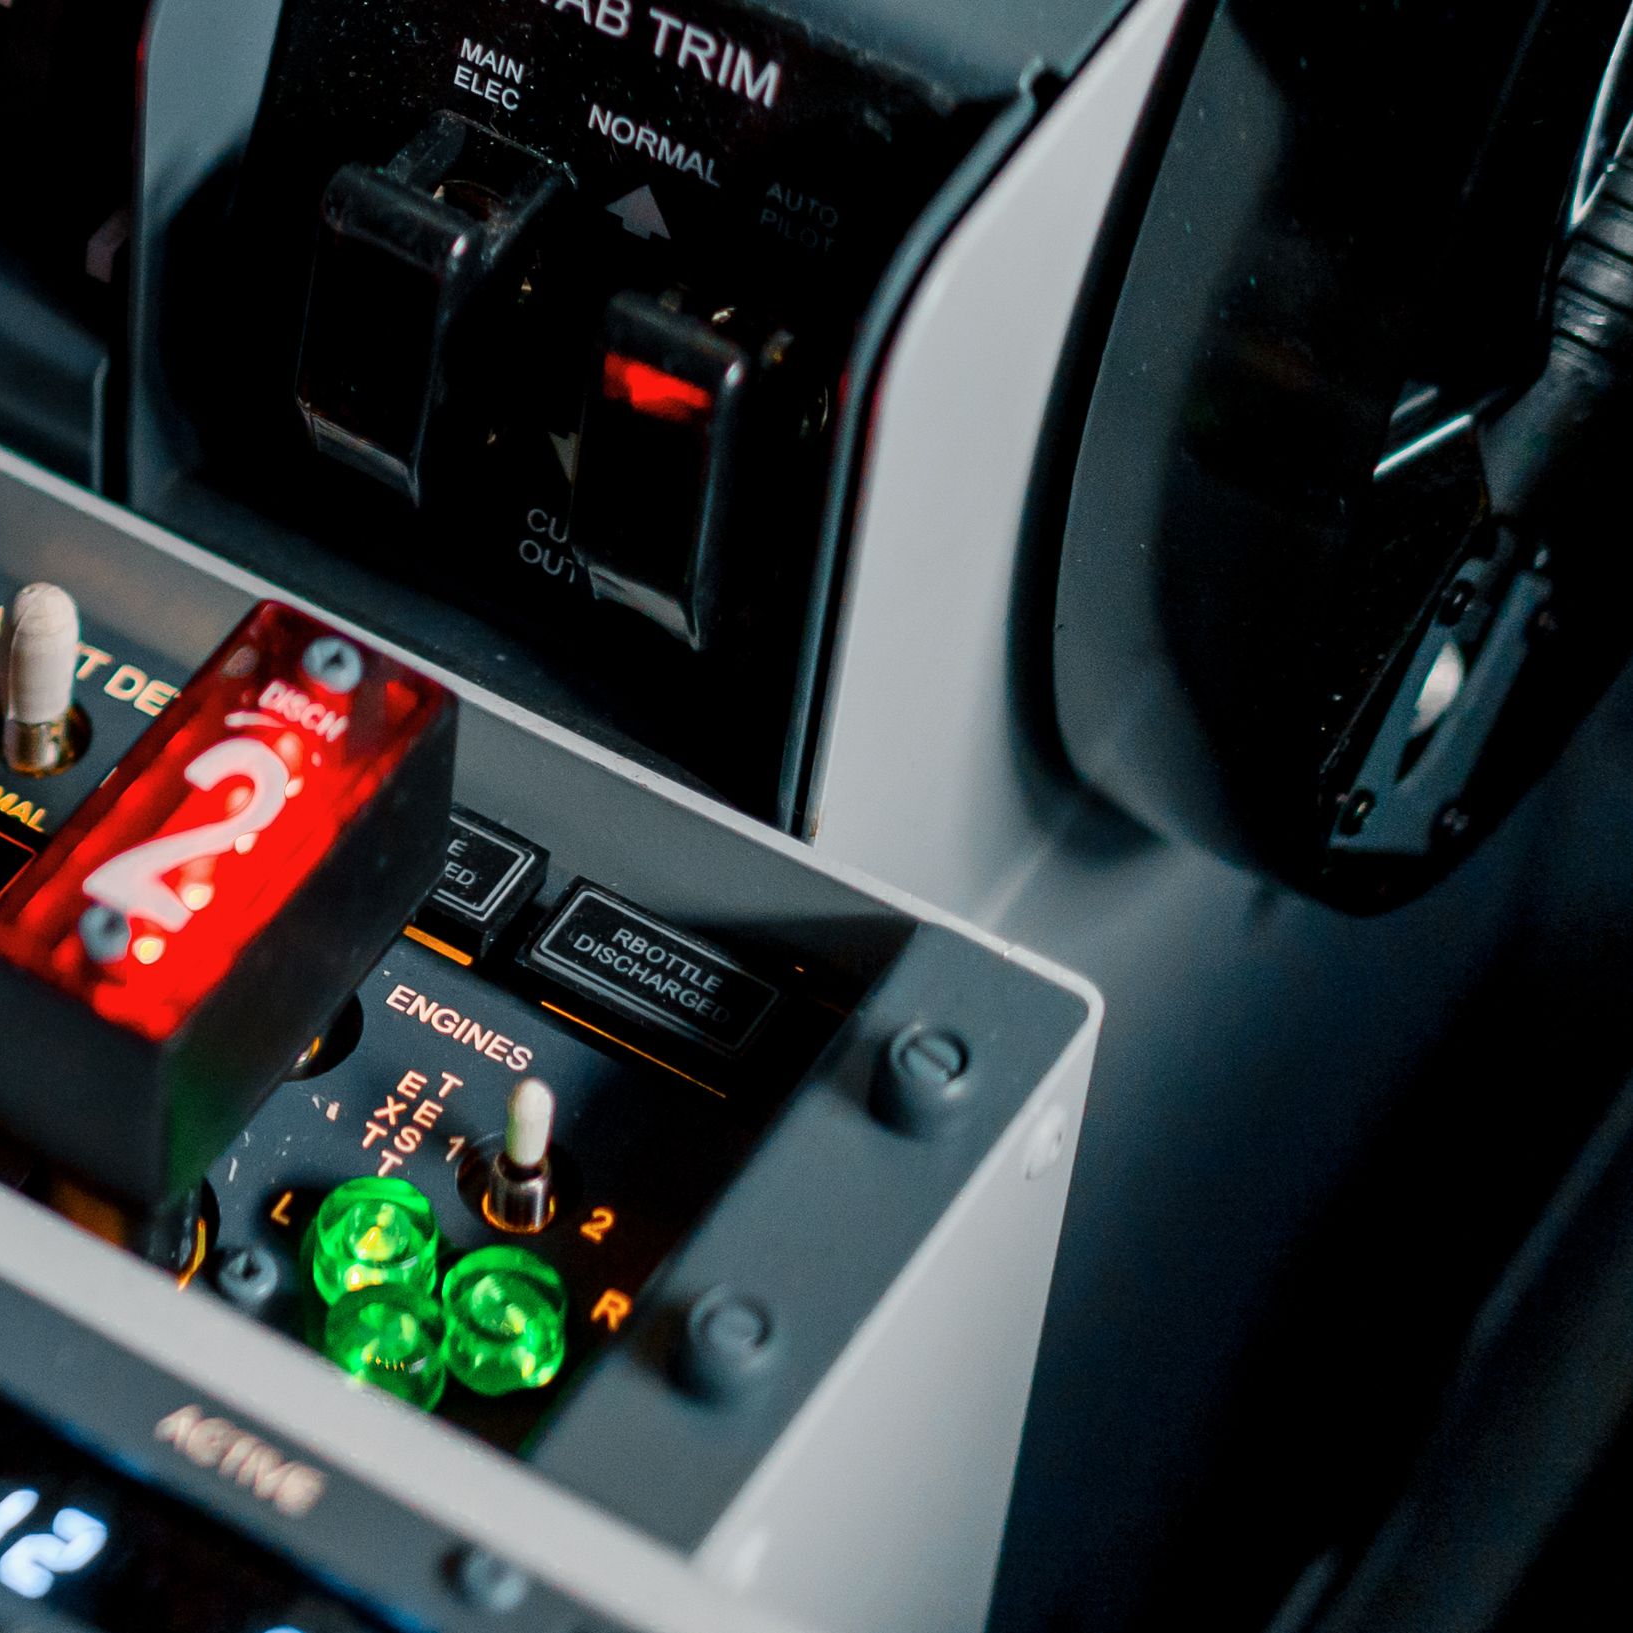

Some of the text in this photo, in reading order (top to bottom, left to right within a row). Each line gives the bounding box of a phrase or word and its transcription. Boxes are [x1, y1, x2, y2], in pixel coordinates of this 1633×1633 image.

[459, 37, 525, 84] MAIN
[648, 8, 782, 109] TRIM
[453, 66, 520, 112] ELEC
[587, 104, 722, 188] NORMAL
[765, 180, 840, 229] AUTO
[526, 508, 569, 544] CU
[103, 663, 183, 718] DE
[259, 680, 348, 742] DISCH
[82, 737, 290, 932] 2
[573, 932, 732, 1024] DISCHARGED
[611, 927, 724, 995] RBOTTLE
[385, 984, 533, 1072] ENGINES
[362, 1069, 428, 1150] EXT
[445, 1136, 465, 1162] 1
[581, 1206, 616, 1245] 2
[592, 1288, 632, 1333] R
